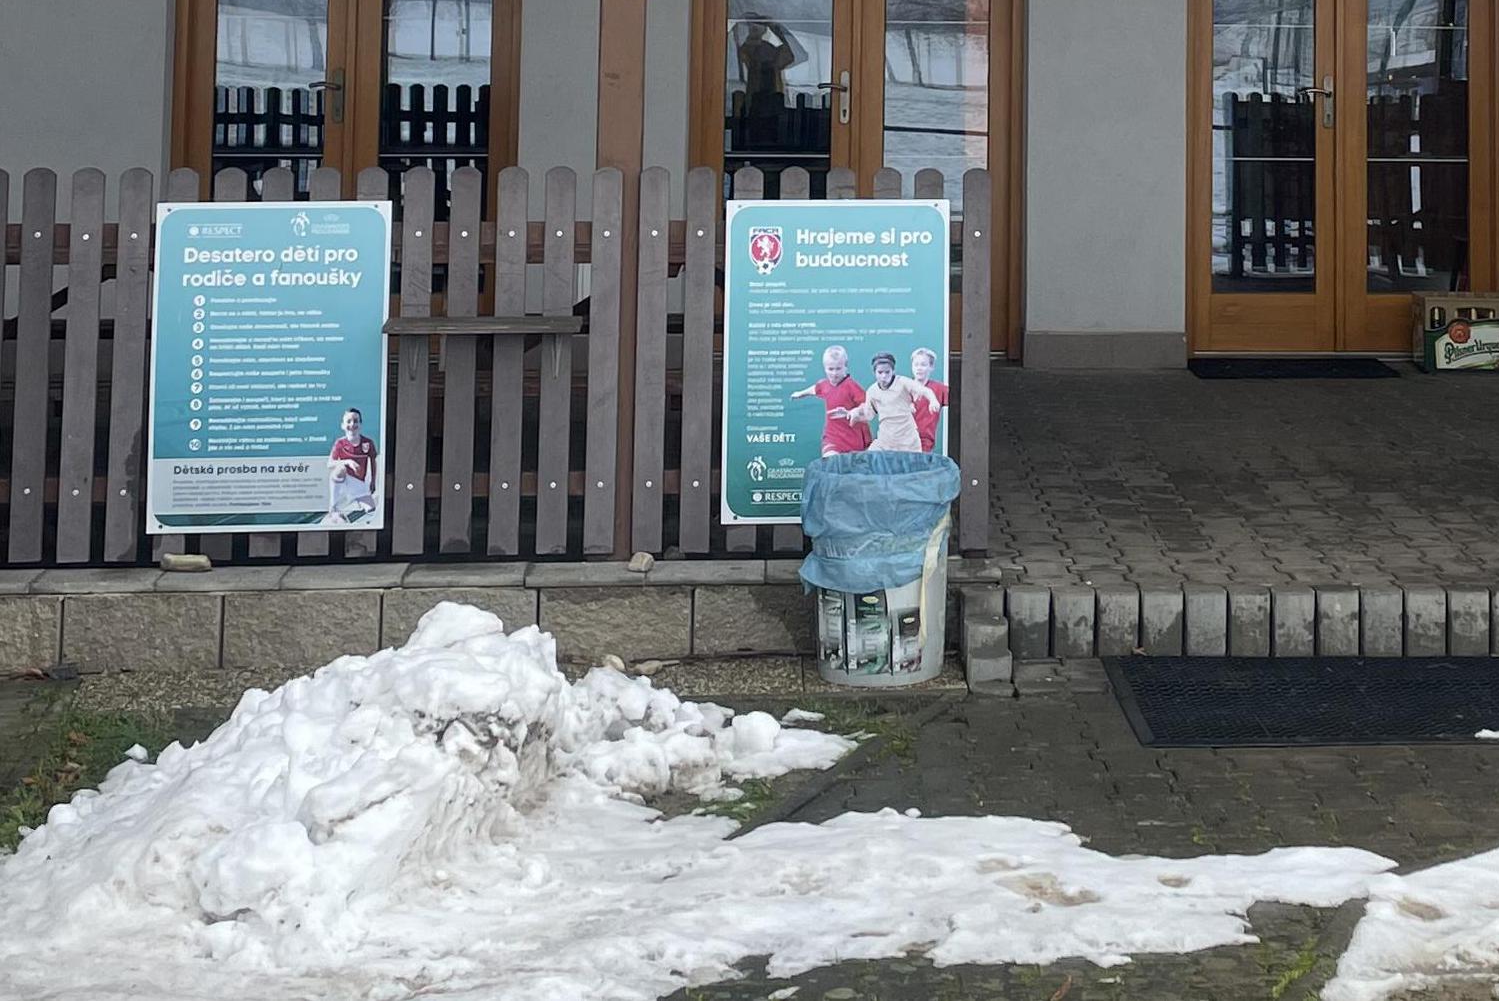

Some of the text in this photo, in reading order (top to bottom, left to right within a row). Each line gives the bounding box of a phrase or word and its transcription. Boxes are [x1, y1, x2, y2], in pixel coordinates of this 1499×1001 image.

[796, 227, 932, 248] Hrajeme si pro
[183, 245, 359, 265] Desatero dětí pro
[795, 251, 909, 268] budoucnost
[182, 268, 362, 288] rodiče a fanoušky
[746, 431, 771, 443] VAŠE
[173, 462, 310, 476] Dětská prosba na závěr
